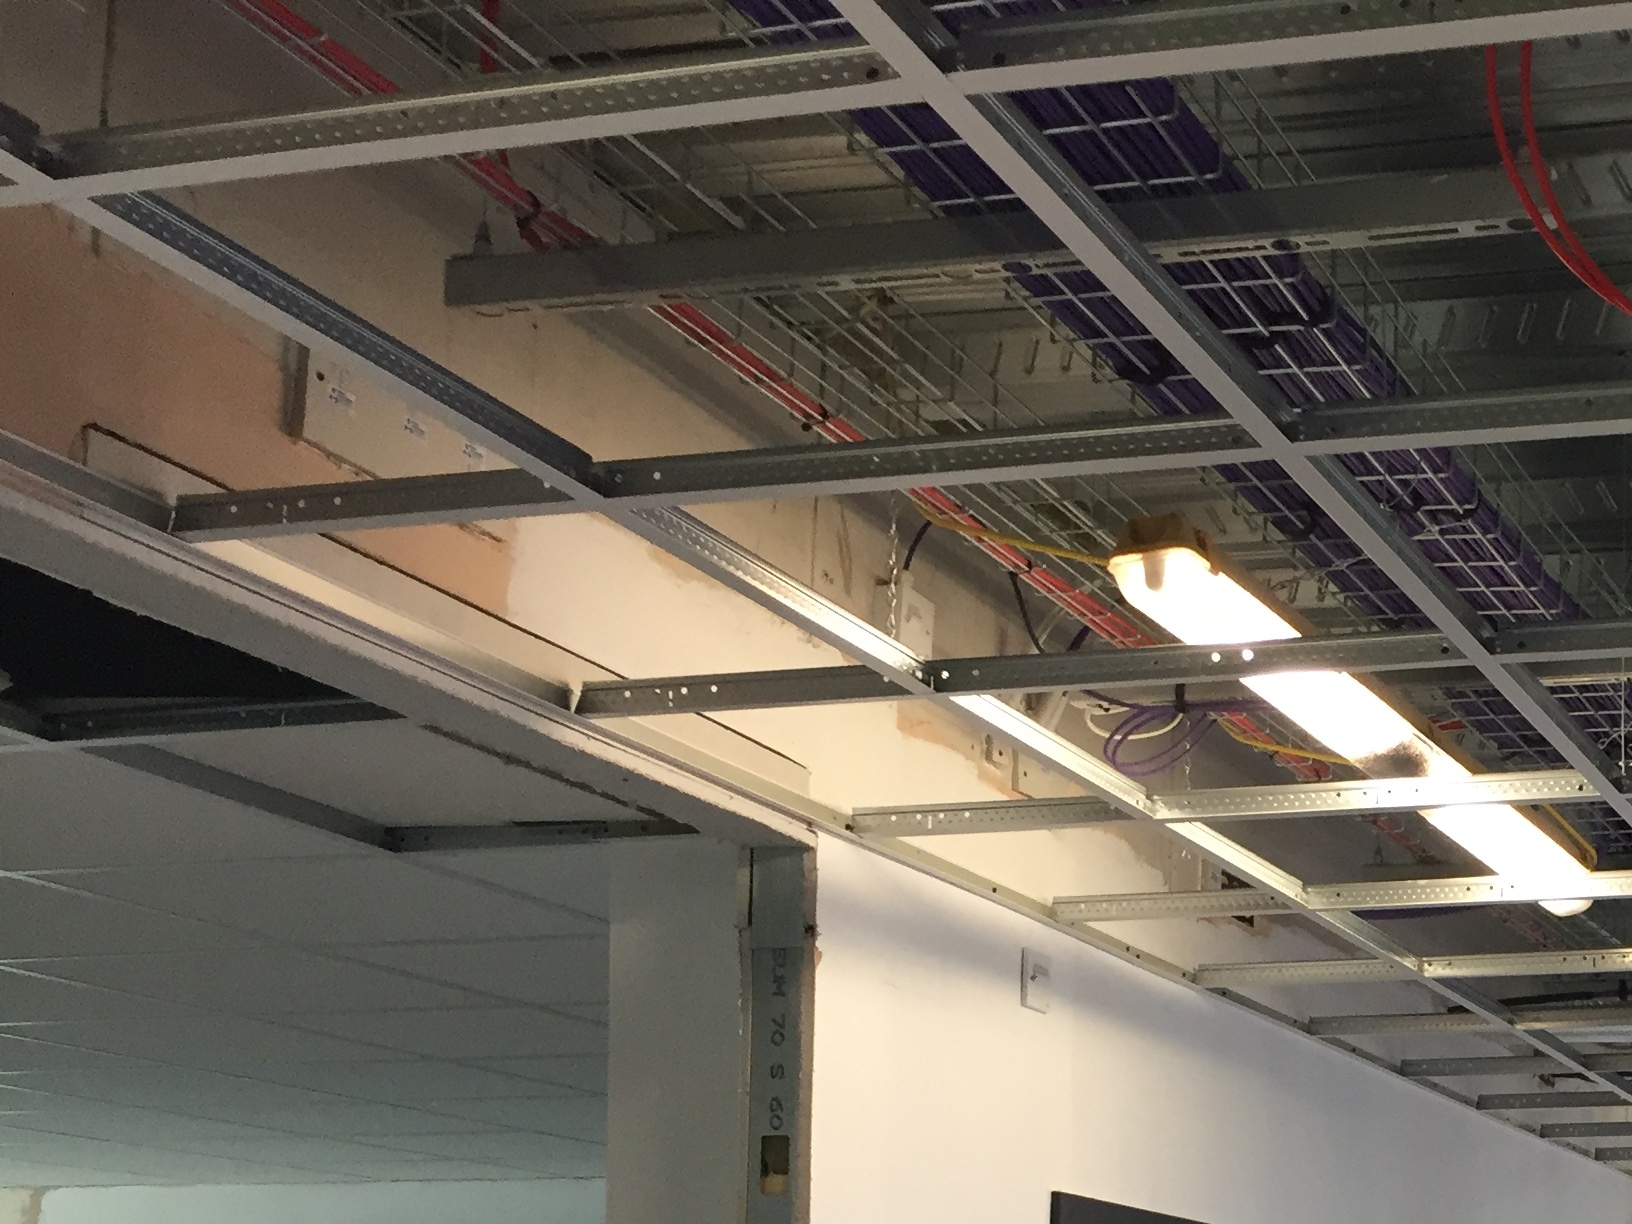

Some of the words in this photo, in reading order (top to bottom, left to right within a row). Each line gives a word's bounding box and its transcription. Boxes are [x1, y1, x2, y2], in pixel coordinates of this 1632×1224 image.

[770, 1014, 786, 1046] 70
[769, 1063, 786, 1080] S
[769, 1096, 784, 1130] 60
